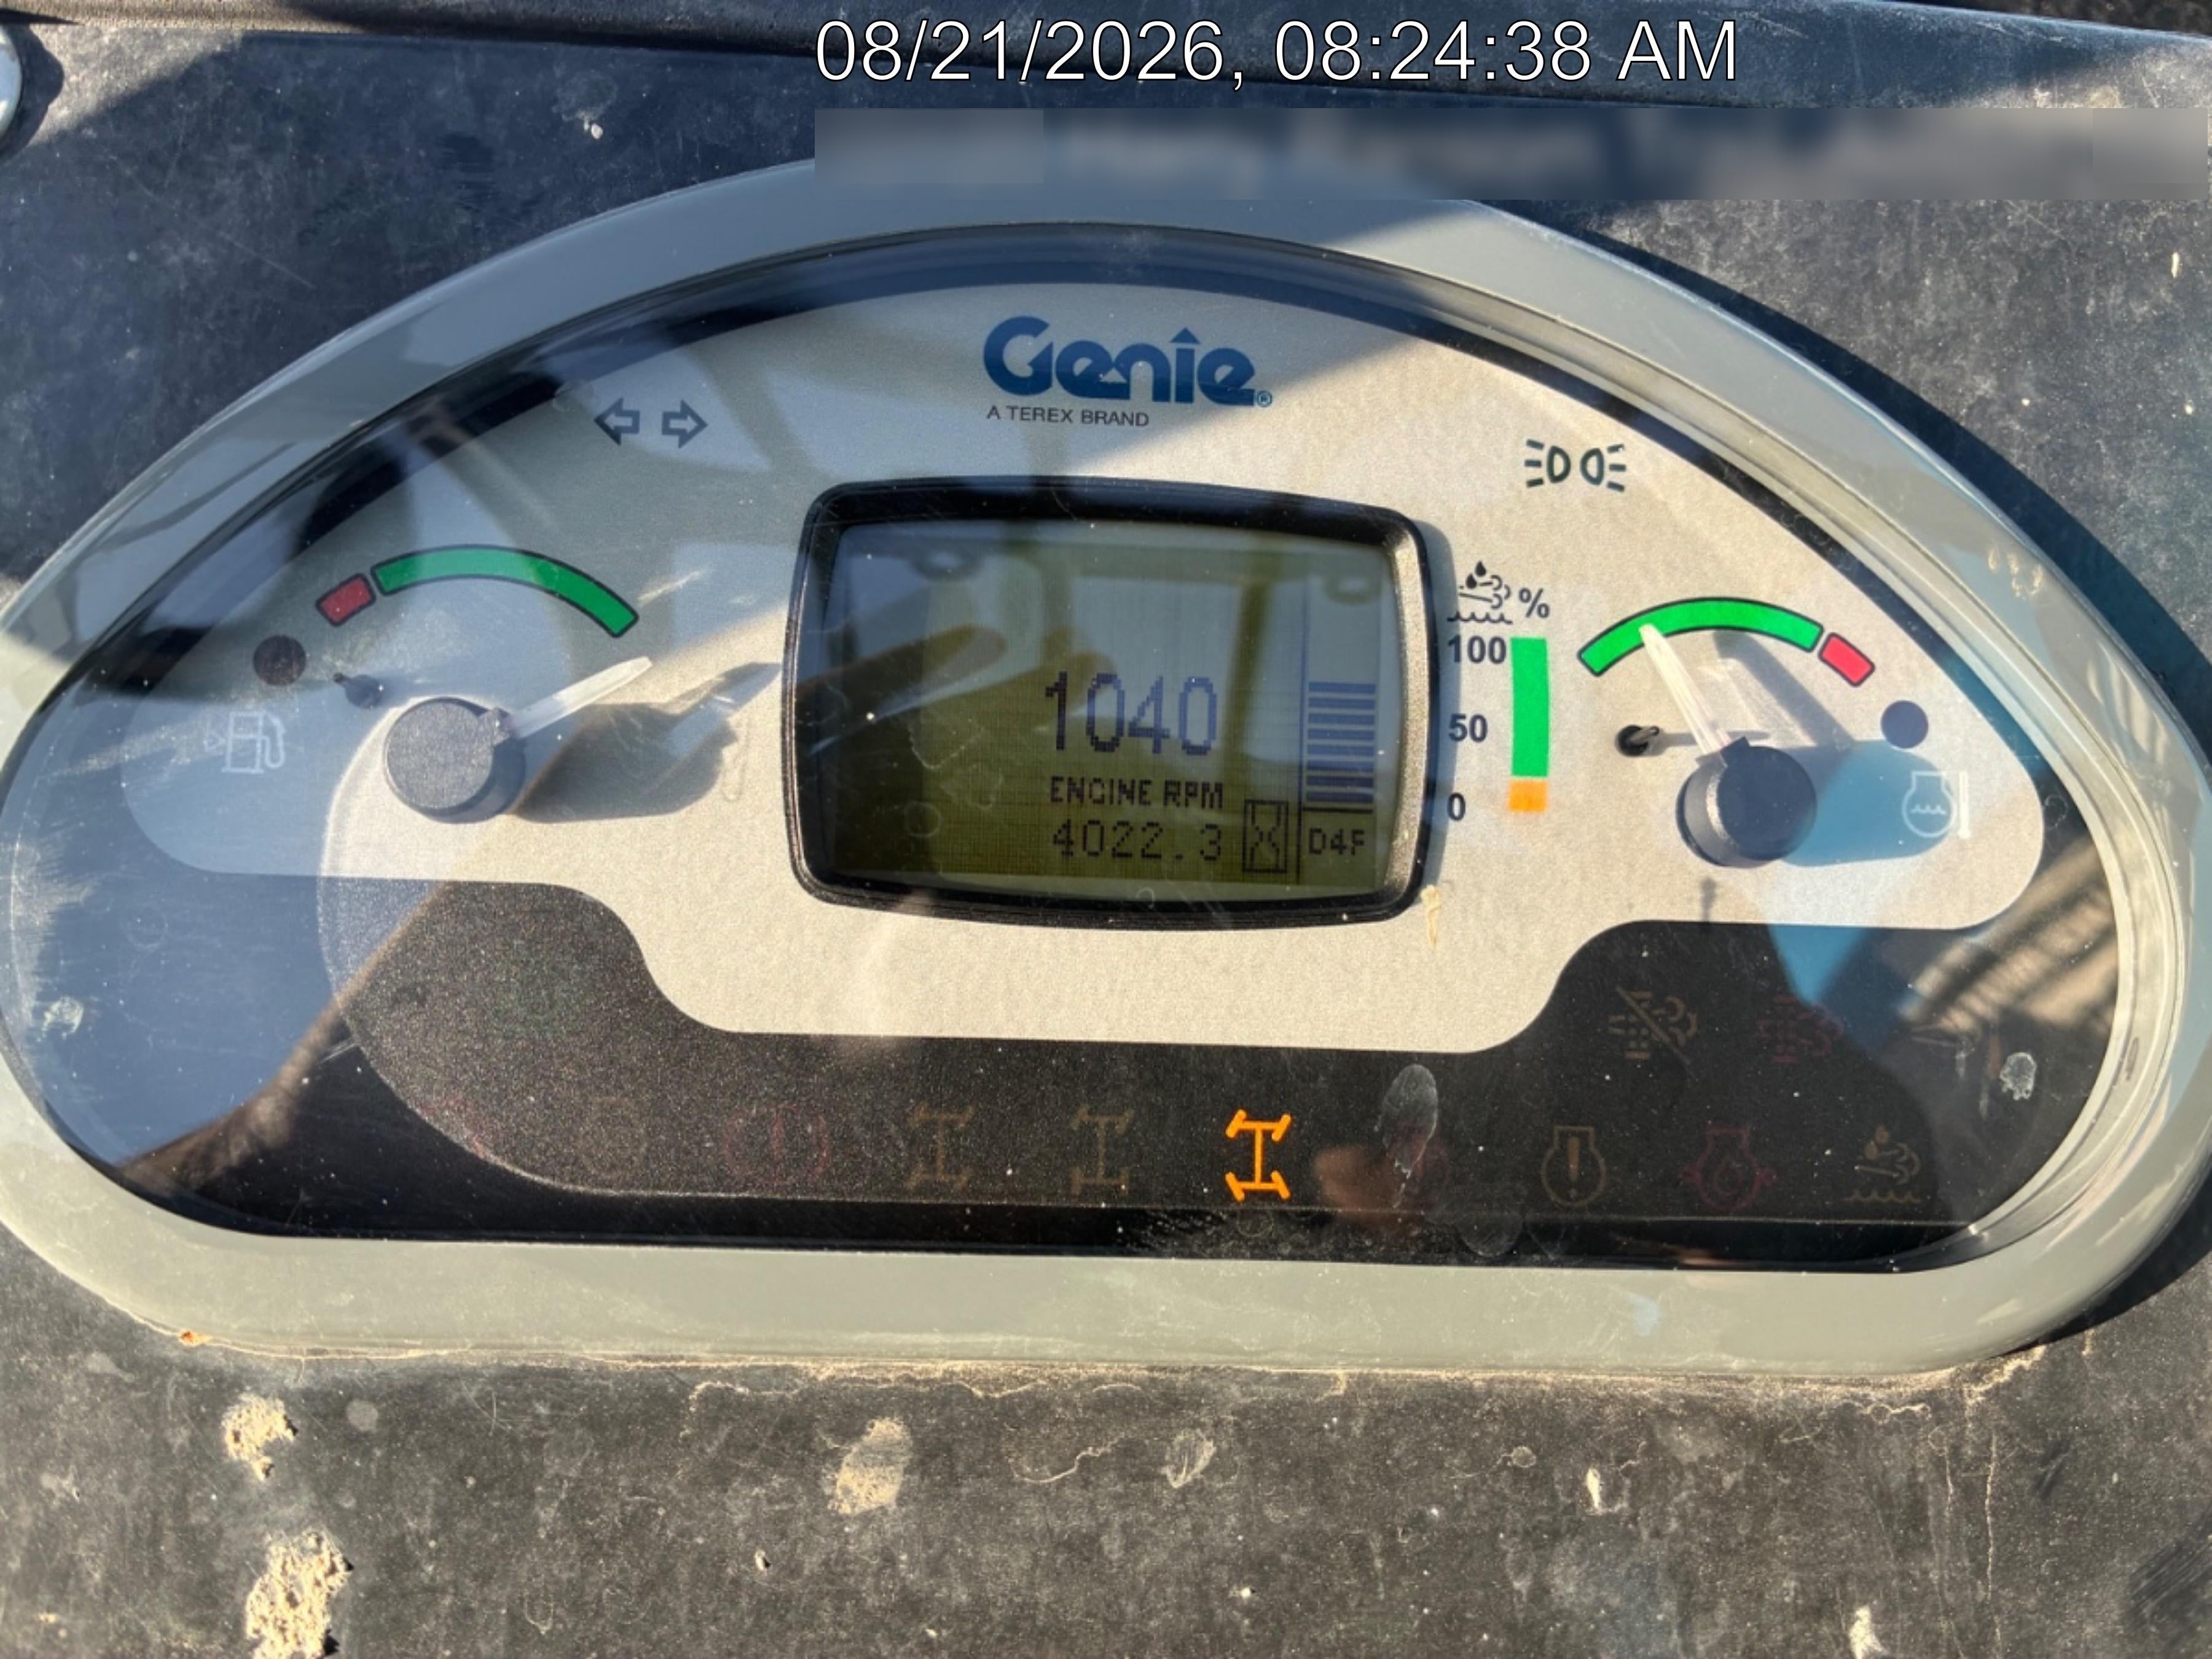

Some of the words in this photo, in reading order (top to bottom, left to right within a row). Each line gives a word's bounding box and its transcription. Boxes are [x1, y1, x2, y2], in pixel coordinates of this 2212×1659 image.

[986, 406, 1000, 420] A
[1006, 406, 1073, 423] TEREX
[1081, 410, 1149, 426] BRAND
[1519, 588, 1550, 618] %
[1448, 635, 1507, 664] 100
[1046, 671, 1217, 756] 1040
[1448, 715, 1488, 742] 50
[1050, 775, 1153, 806] ENGINE
[1163, 780, 1223, 809] RPM
[1447, 793, 1465, 820] 0
[1053, 819, 1222, 861] 4022.3
[1308, 828, 1365, 855] D4F
